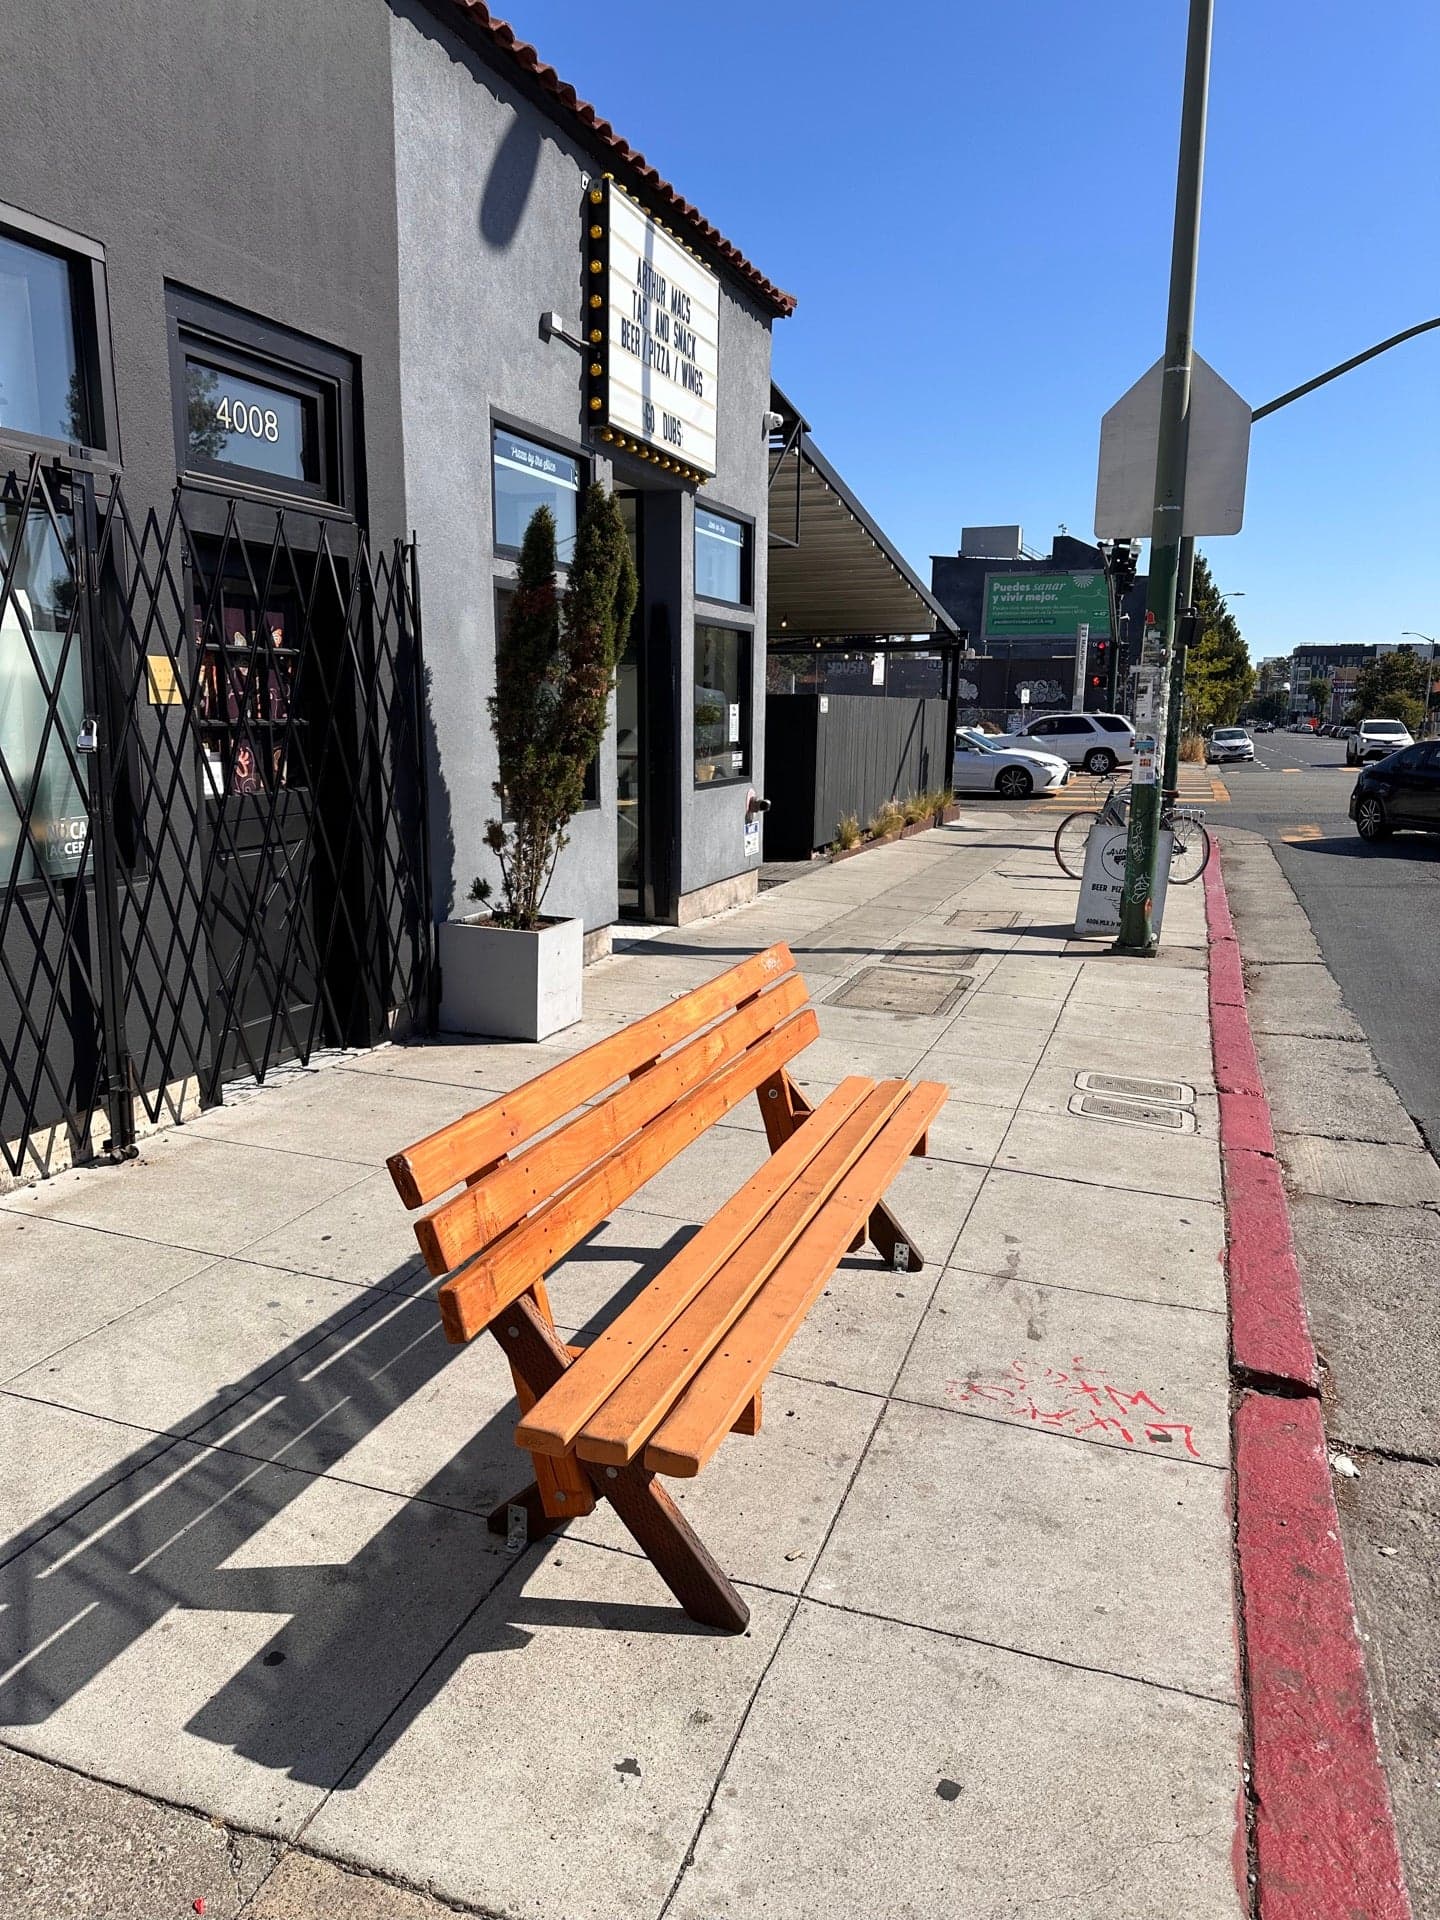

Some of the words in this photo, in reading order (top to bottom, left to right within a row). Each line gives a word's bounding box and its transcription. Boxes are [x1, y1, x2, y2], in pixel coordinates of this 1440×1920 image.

[637, 257, 666, 308] ARTHUR
[670, 285, 691, 324] MACS
[632, 289, 648, 326] TAP
[655, 308, 670, 346] AND
[673, 320, 696, 363] SNACK
[621, 317, 641, 358] BEER
[649, 337, 671, 378] PIZZA
[673, 355, 678, 382] /
[681, 359, 703, 398] WINGS
[216, 396, 279, 442] 4008
[663, 411, 681, 447] DUBS
[992, 594, 999, 605] y
[1000, 592, 1024, 602] vivir
[1025, 591, 1059, 604] mejor.
[993, 581, 1031, 592] Puedes
[1033, 583, 1067, 591] sanar
[1091, 883, 1108, 892] BEER
